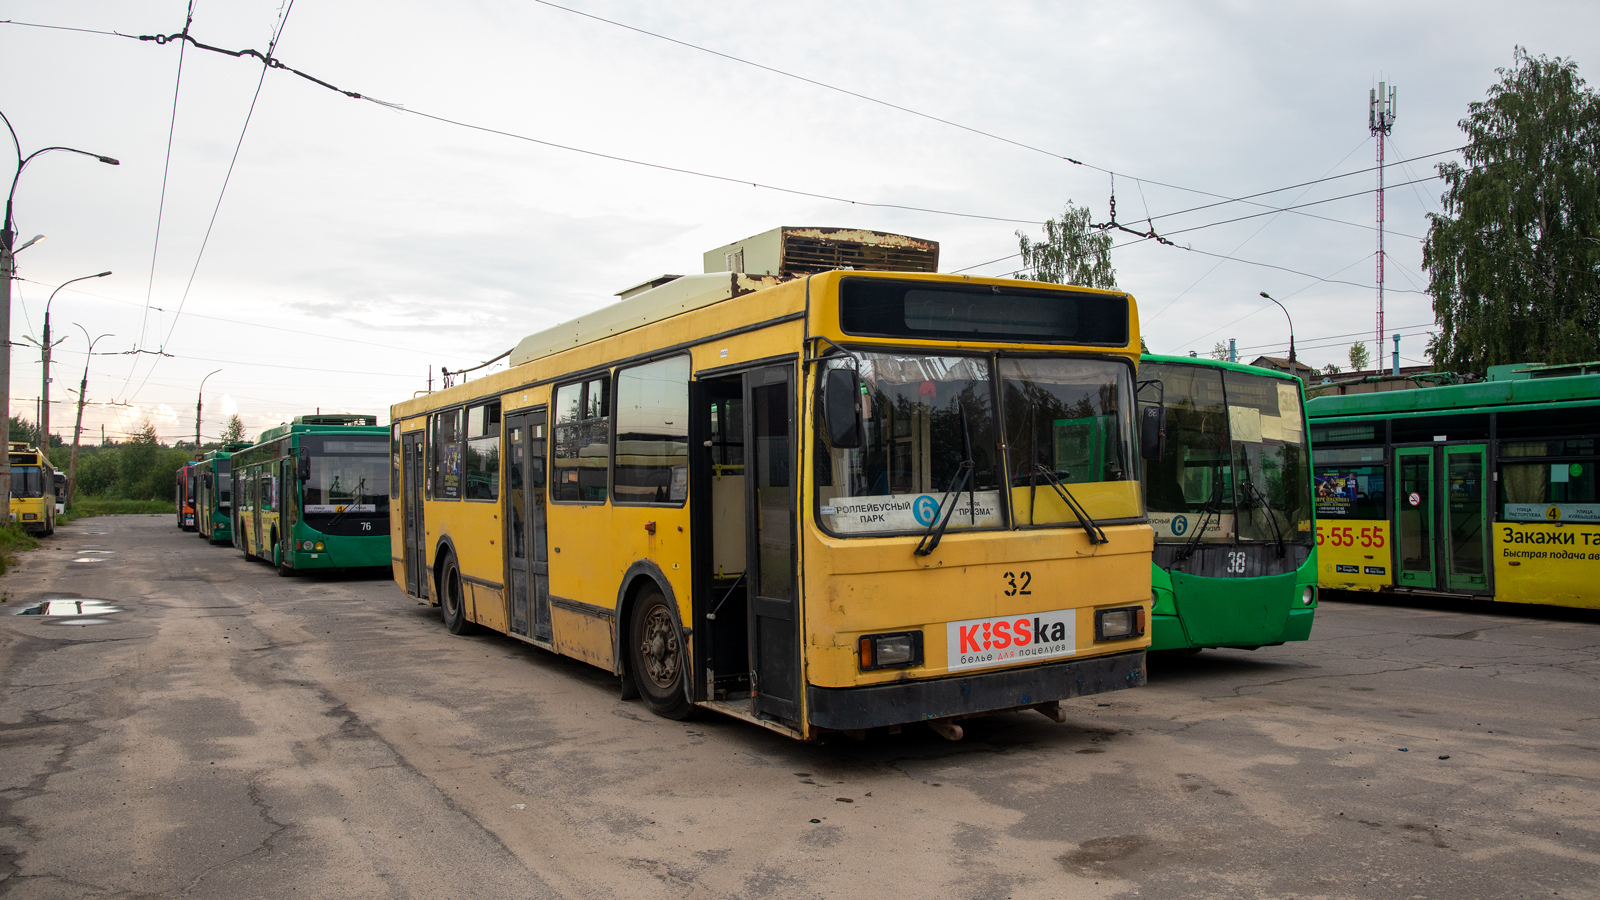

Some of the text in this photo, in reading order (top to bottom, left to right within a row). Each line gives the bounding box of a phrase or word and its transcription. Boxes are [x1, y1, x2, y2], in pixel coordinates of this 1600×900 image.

[860, 514, 885, 523] ПАРК
[918, 497, 935, 523] 6
[1548, 507, 1557, 520] 4
[360, 522, 372, 531] 76
[1175, 517, 1185, 533] 6
[1503, 527, 1575, 545] Закажи
[1227, 551, 1246, 574] 38
[1503, 548, 1547, 560] Быстрая
[1550, 549, 1586, 560] подача
[1003, 571, 1032, 597] 32
[960, 643, 1066, 664] белье для поцелуев
